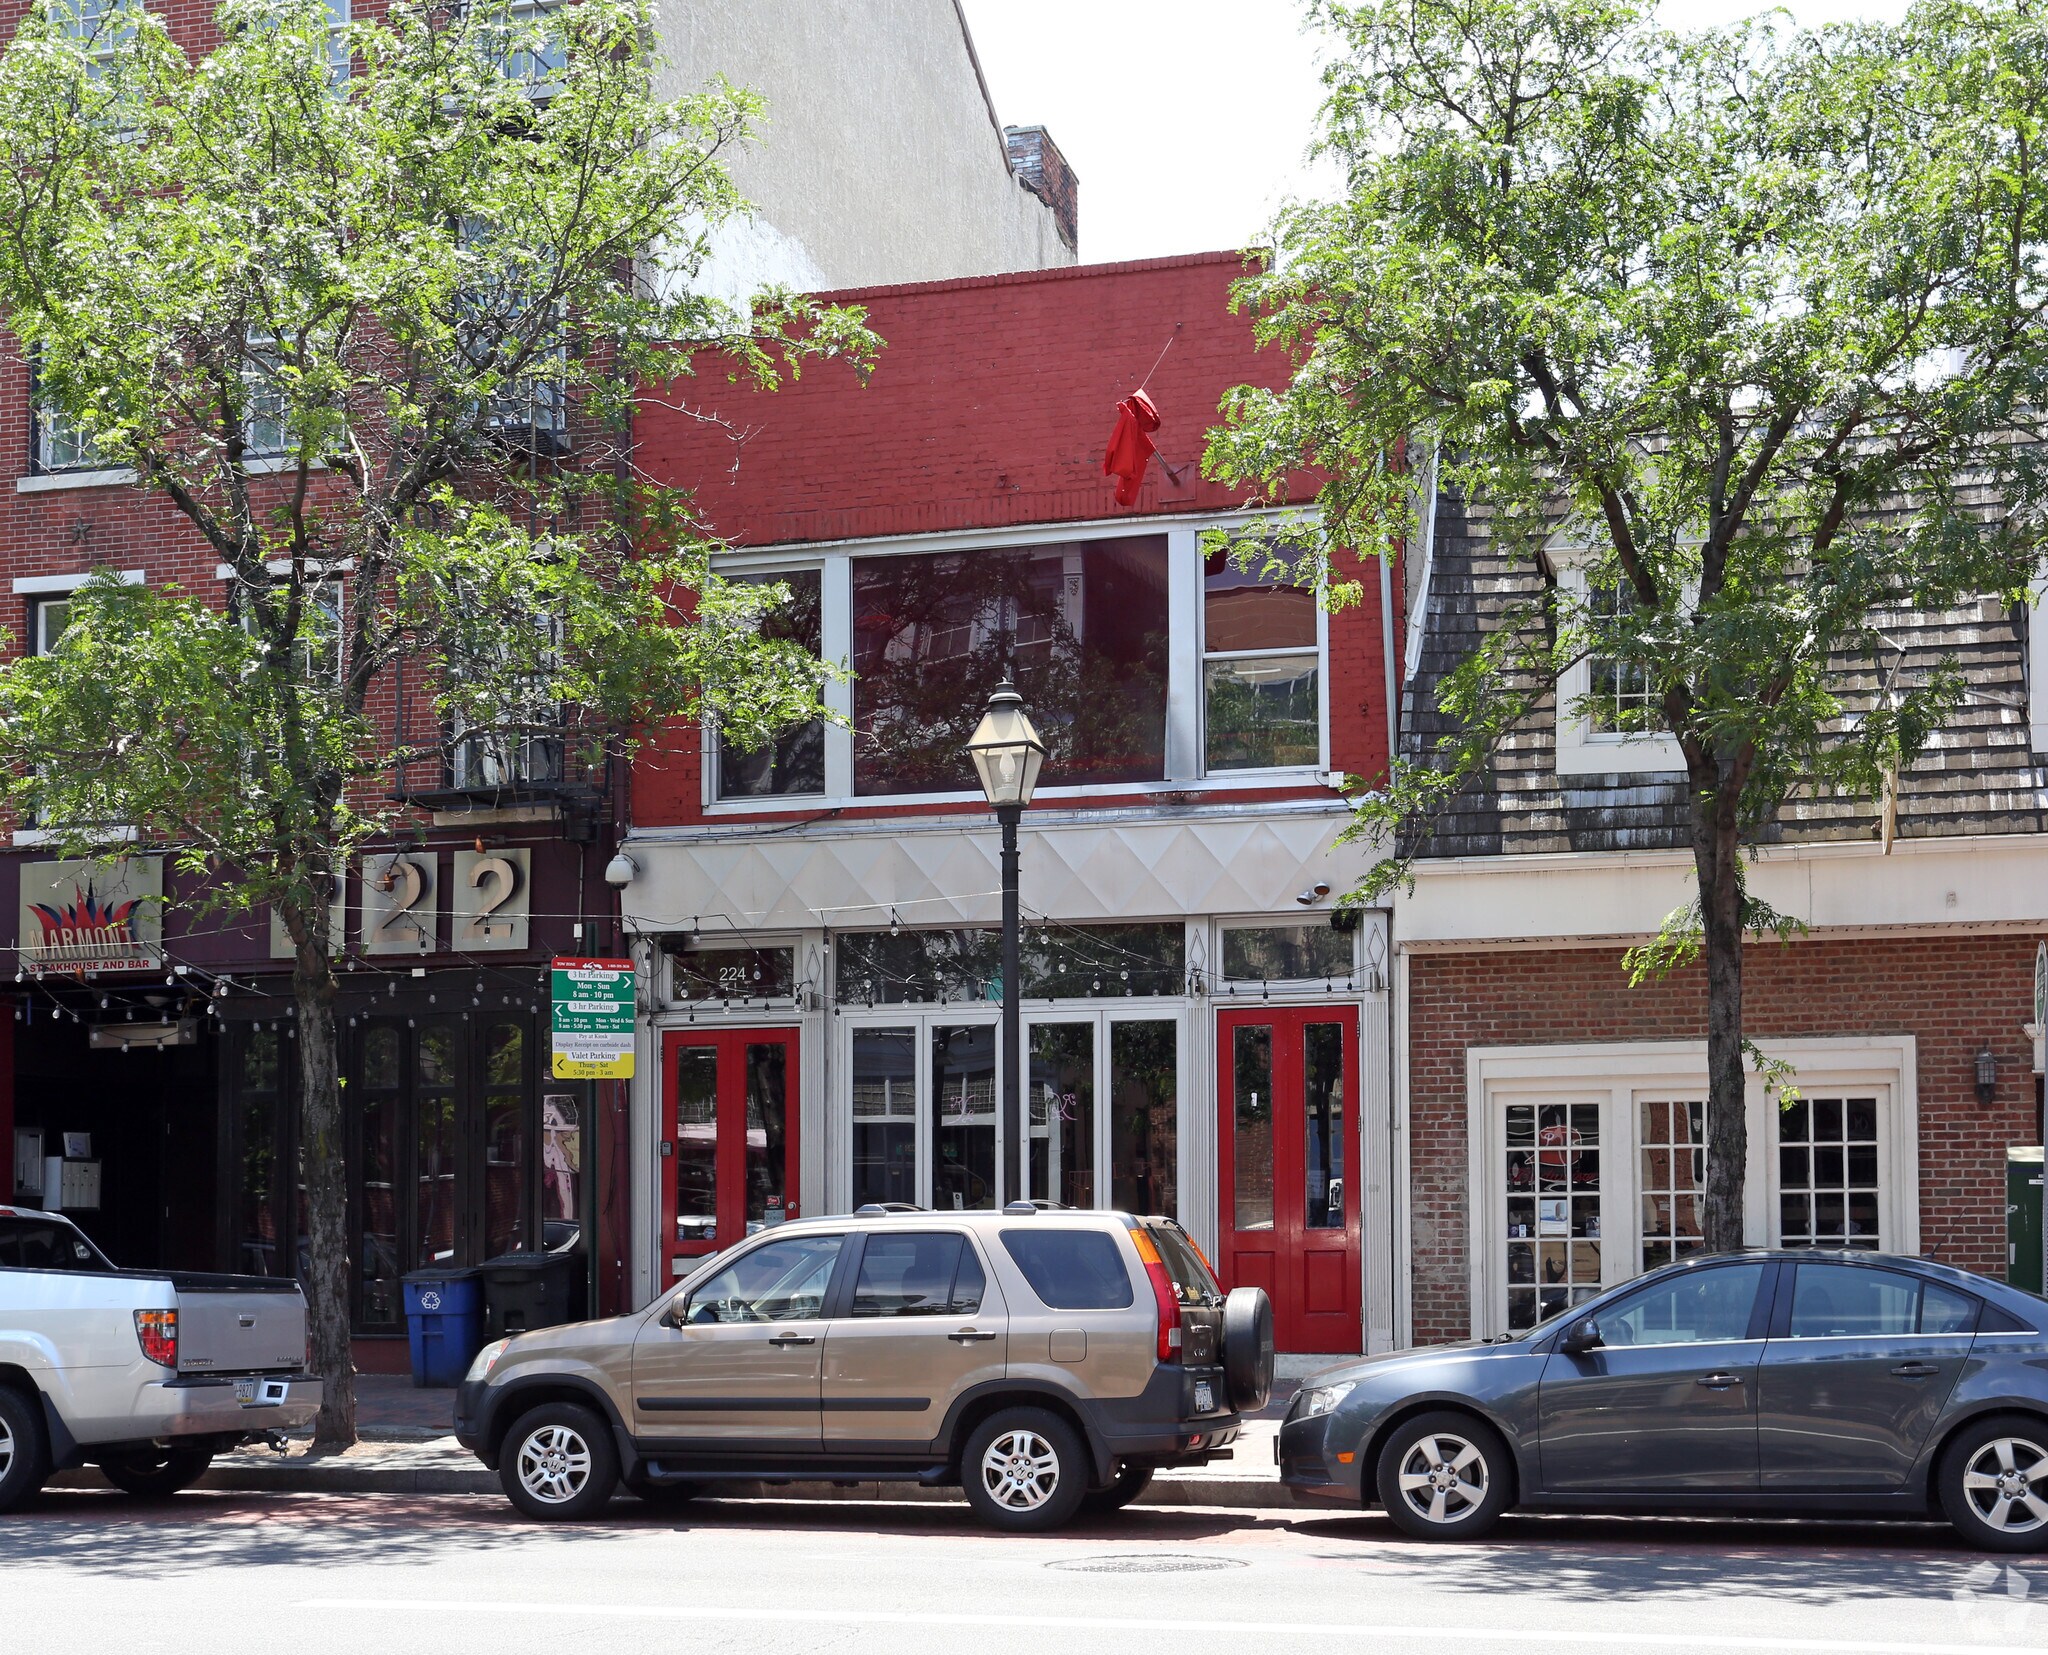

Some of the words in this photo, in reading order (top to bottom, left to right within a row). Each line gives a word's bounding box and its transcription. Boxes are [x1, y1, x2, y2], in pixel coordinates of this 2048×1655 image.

[30, 926, 134, 959] MARMONT
[103, 960, 124, 969] AND
[128, 960, 149, 968] BAR
[588, 972, 614, 980] Parking
[719, 967, 746, 981] 224
[597, 982, 610, 990] Sun
[588, 1003, 614, 1011] Parking
[590, 1052, 616, 1060] Parking
